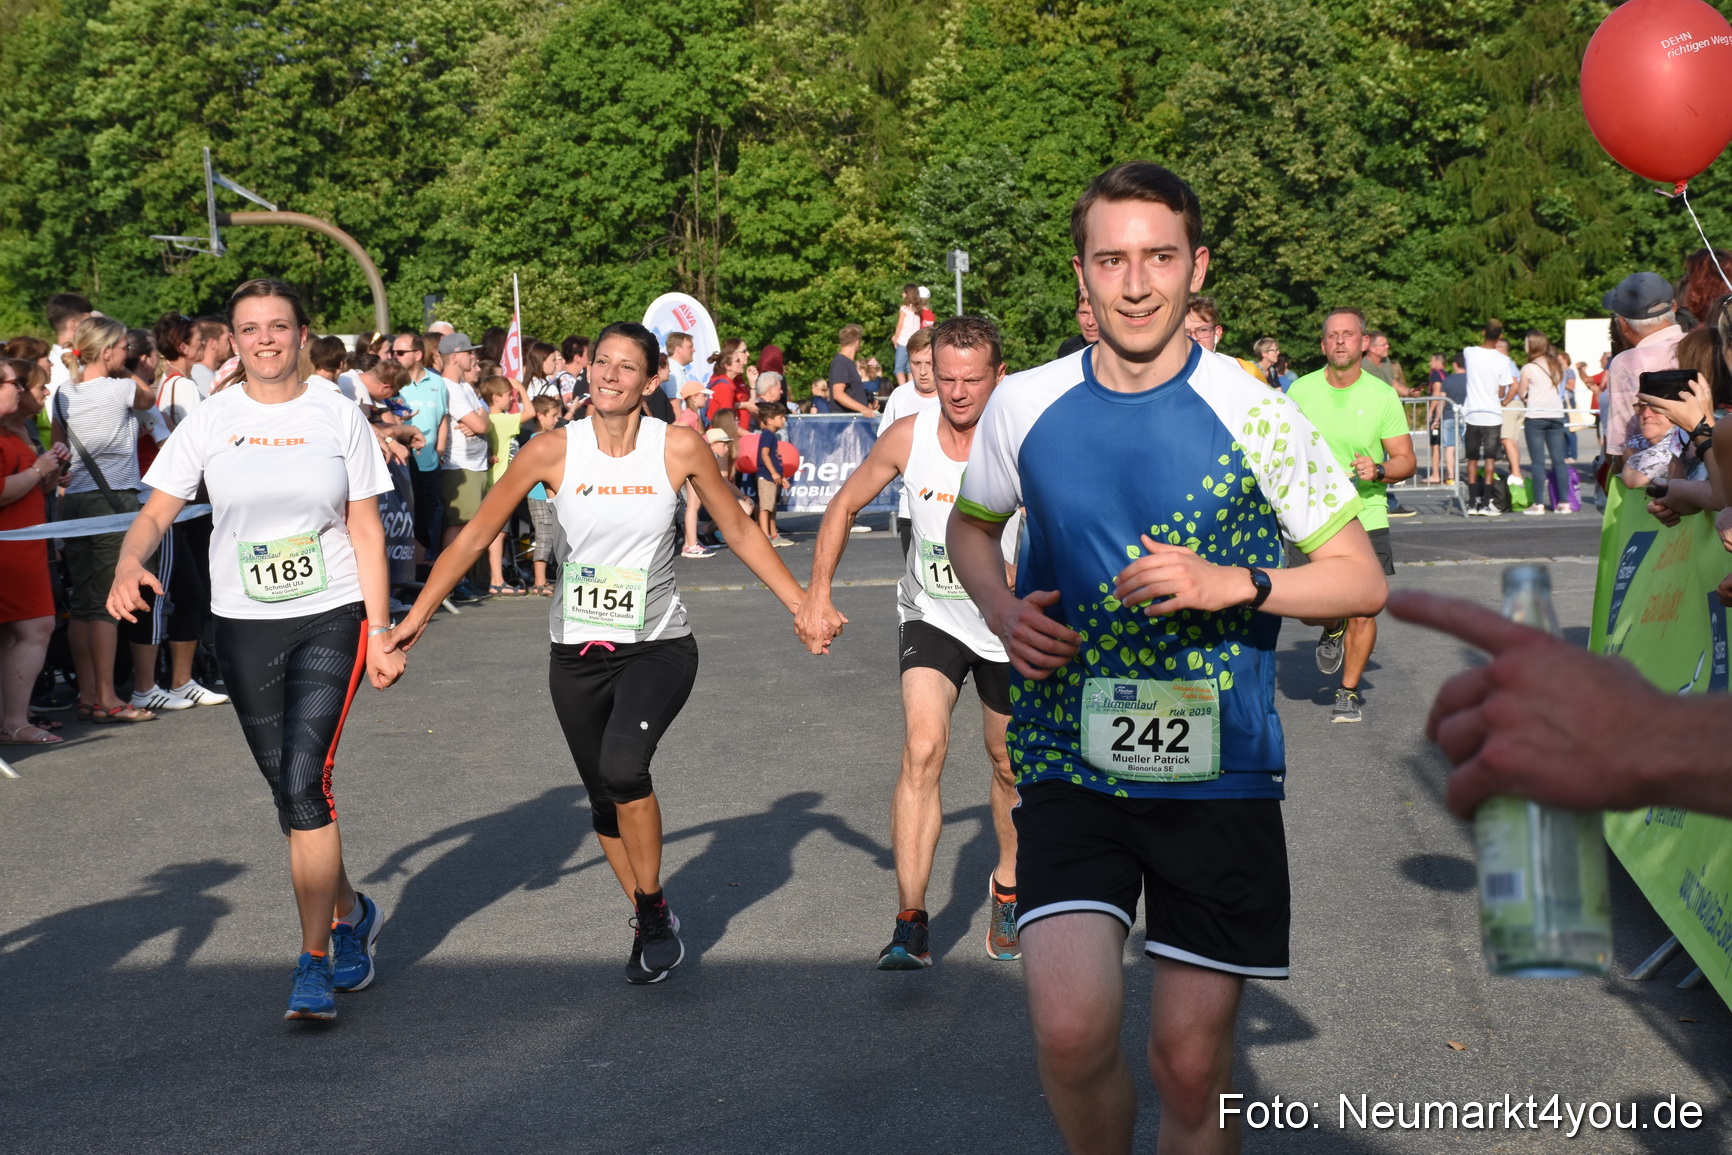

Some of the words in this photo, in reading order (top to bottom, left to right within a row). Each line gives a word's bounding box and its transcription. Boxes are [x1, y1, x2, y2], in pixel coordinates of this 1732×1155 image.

[1661, 31, 1692, 49] DEHN
[1667, 39, 1710, 58] richtigen
[1710, 35, 1730, 45] Weg
[249, 437, 310, 447] KLEBL
[597, 485, 658, 495] KLEBL
[250, 556, 313, 585] 1183
[929, 562, 954, 584] 11
[264, 582, 292, 592] Schmidt
[936, 583, 953, 591] Meyer
[573, 585, 634, 612] 1154
[571, 605, 608, 618] Ehrnsberger
[609, 611, 634, 619] Claudia
[1103, 699, 1158, 710] firmenlauf
[1188, 706, 1212, 717] 2019
[1110, 716, 1190, 753] 242
[1112, 753, 1151, 764] Mueller
[1153, 755, 1190, 764] Patrick
[1127, 764, 1162, 772] Bionorica
